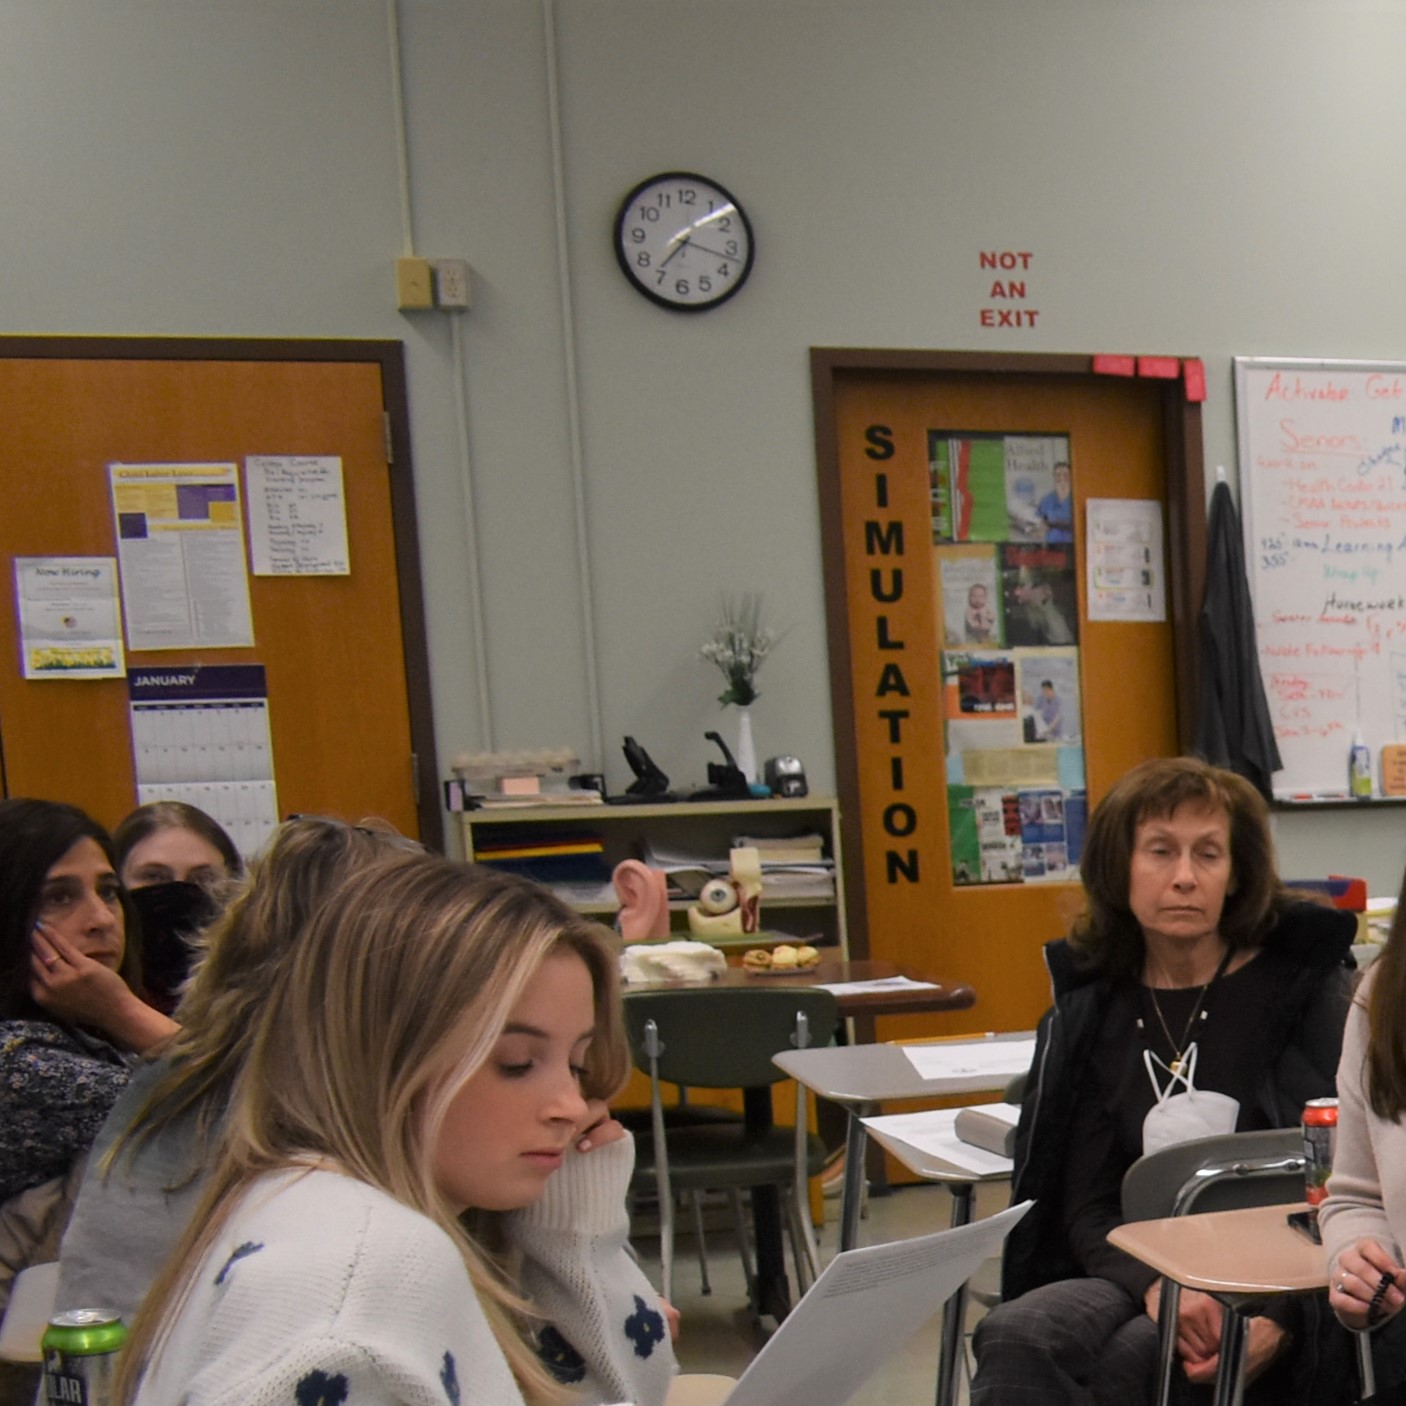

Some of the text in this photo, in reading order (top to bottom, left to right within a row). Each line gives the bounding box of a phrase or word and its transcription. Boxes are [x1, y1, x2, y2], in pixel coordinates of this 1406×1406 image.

[657, 193, 672, 207] 11
[677, 190, 697, 205] 12
[640, 206, 660, 222] 10
[707, 200, 715, 213] 1
[718, 217, 731, 232] 2
[632, 228, 646, 244] 9
[725, 240, 738, 257] 3
[637, 251, 651, 268] 8
[979, 252, 1033, 270] NOT
[656, 270, 666, 285] 7
[717, 262, 731, 278] 4
[676, 279, 690, 295] 6
[699, 276, 712, 292] 5
[990, 281, 1026, 299] AN
[979, 309, 1040, 328] EXIT
[1322, 533, 1393, 562] Learning
[133, 674, 197, 688] JANUARY
